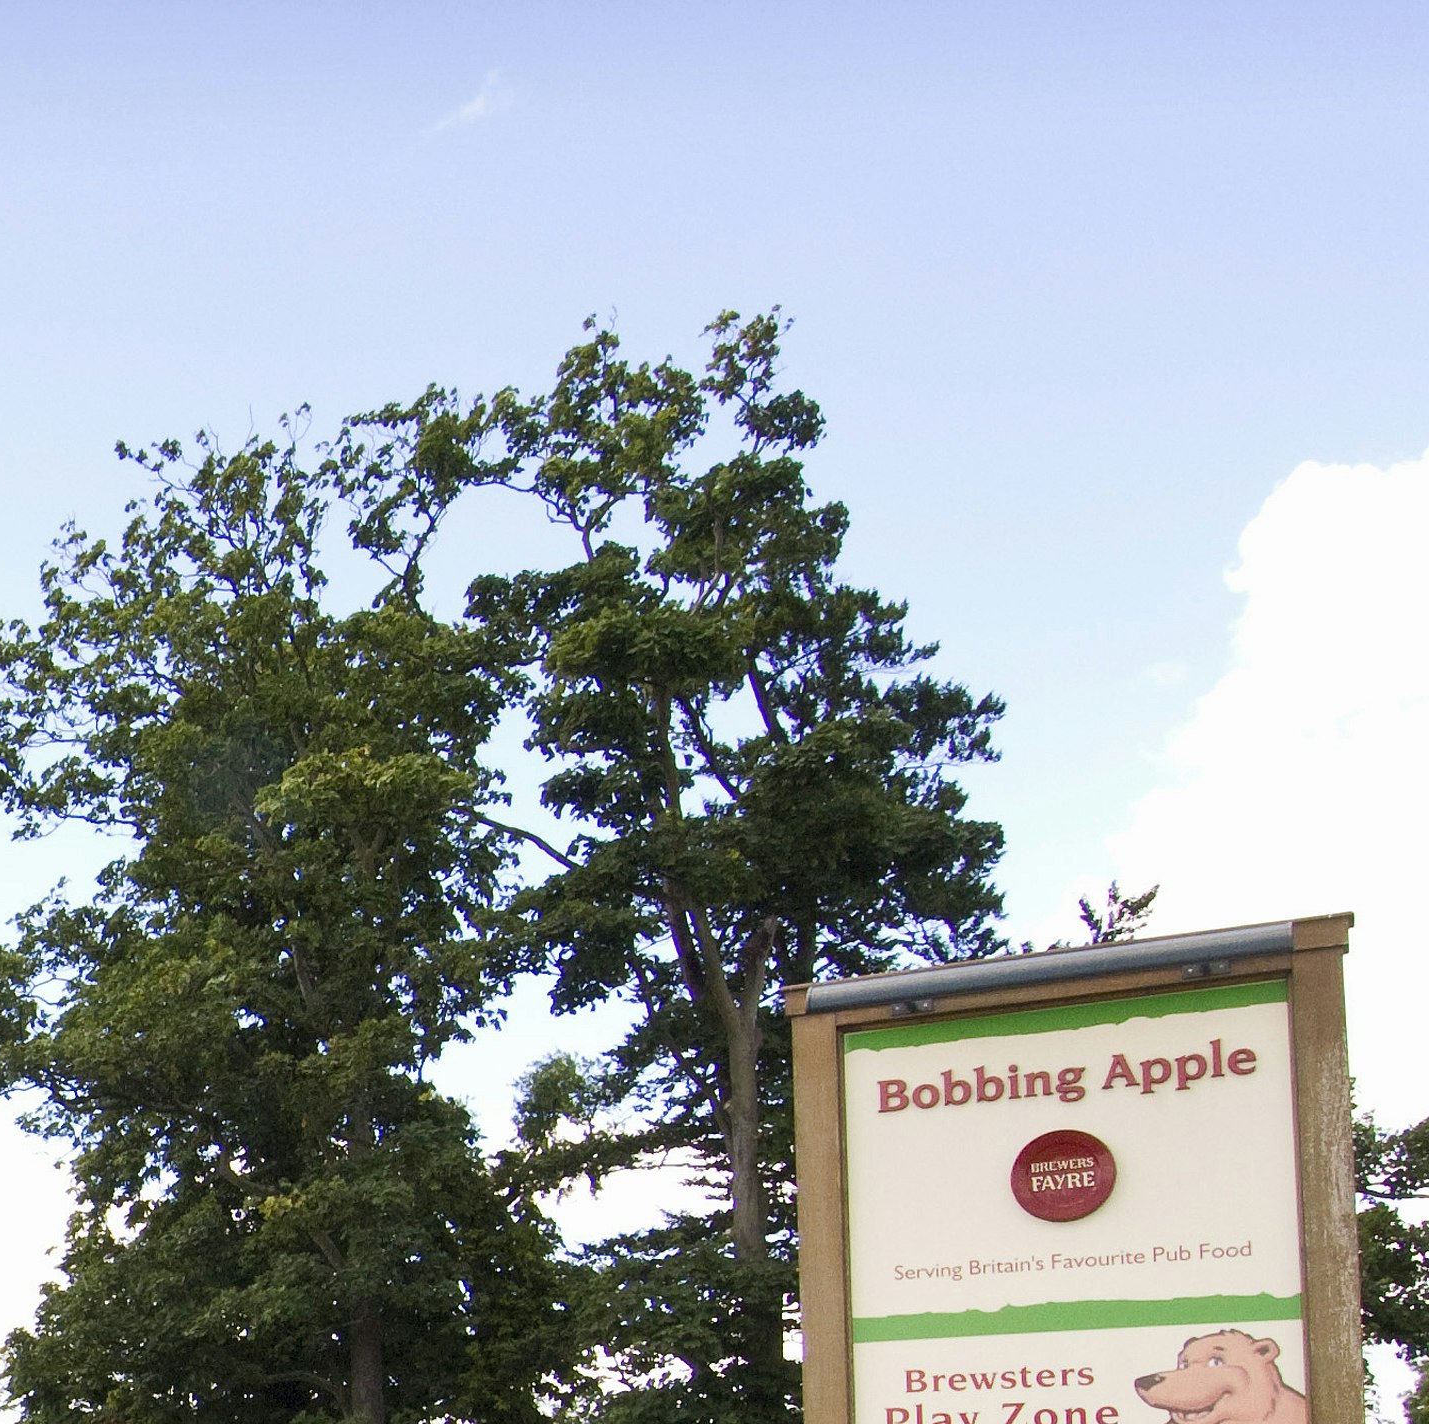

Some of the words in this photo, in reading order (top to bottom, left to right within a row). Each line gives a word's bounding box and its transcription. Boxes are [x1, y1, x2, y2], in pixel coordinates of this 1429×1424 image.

[877, 1064, 1086, 1114] Bobbing
[1102, 1038, 1257, 1094] Apple
[1030, 1157, 1094, 1173] BREWERS
[1031, 1171, 1095, 1192] FAYRE
[894, 1265, 963, 1281] Serving
[969, 1256, 1044, 1276] Britain's
[1051, 1250, 1145, 1270] Favourite
[1153, 1245, 1191, 1262] Pub
[1199, 1240, 1252, 1259] Food
[904, 1364, 1094, 1394] Brewsters
